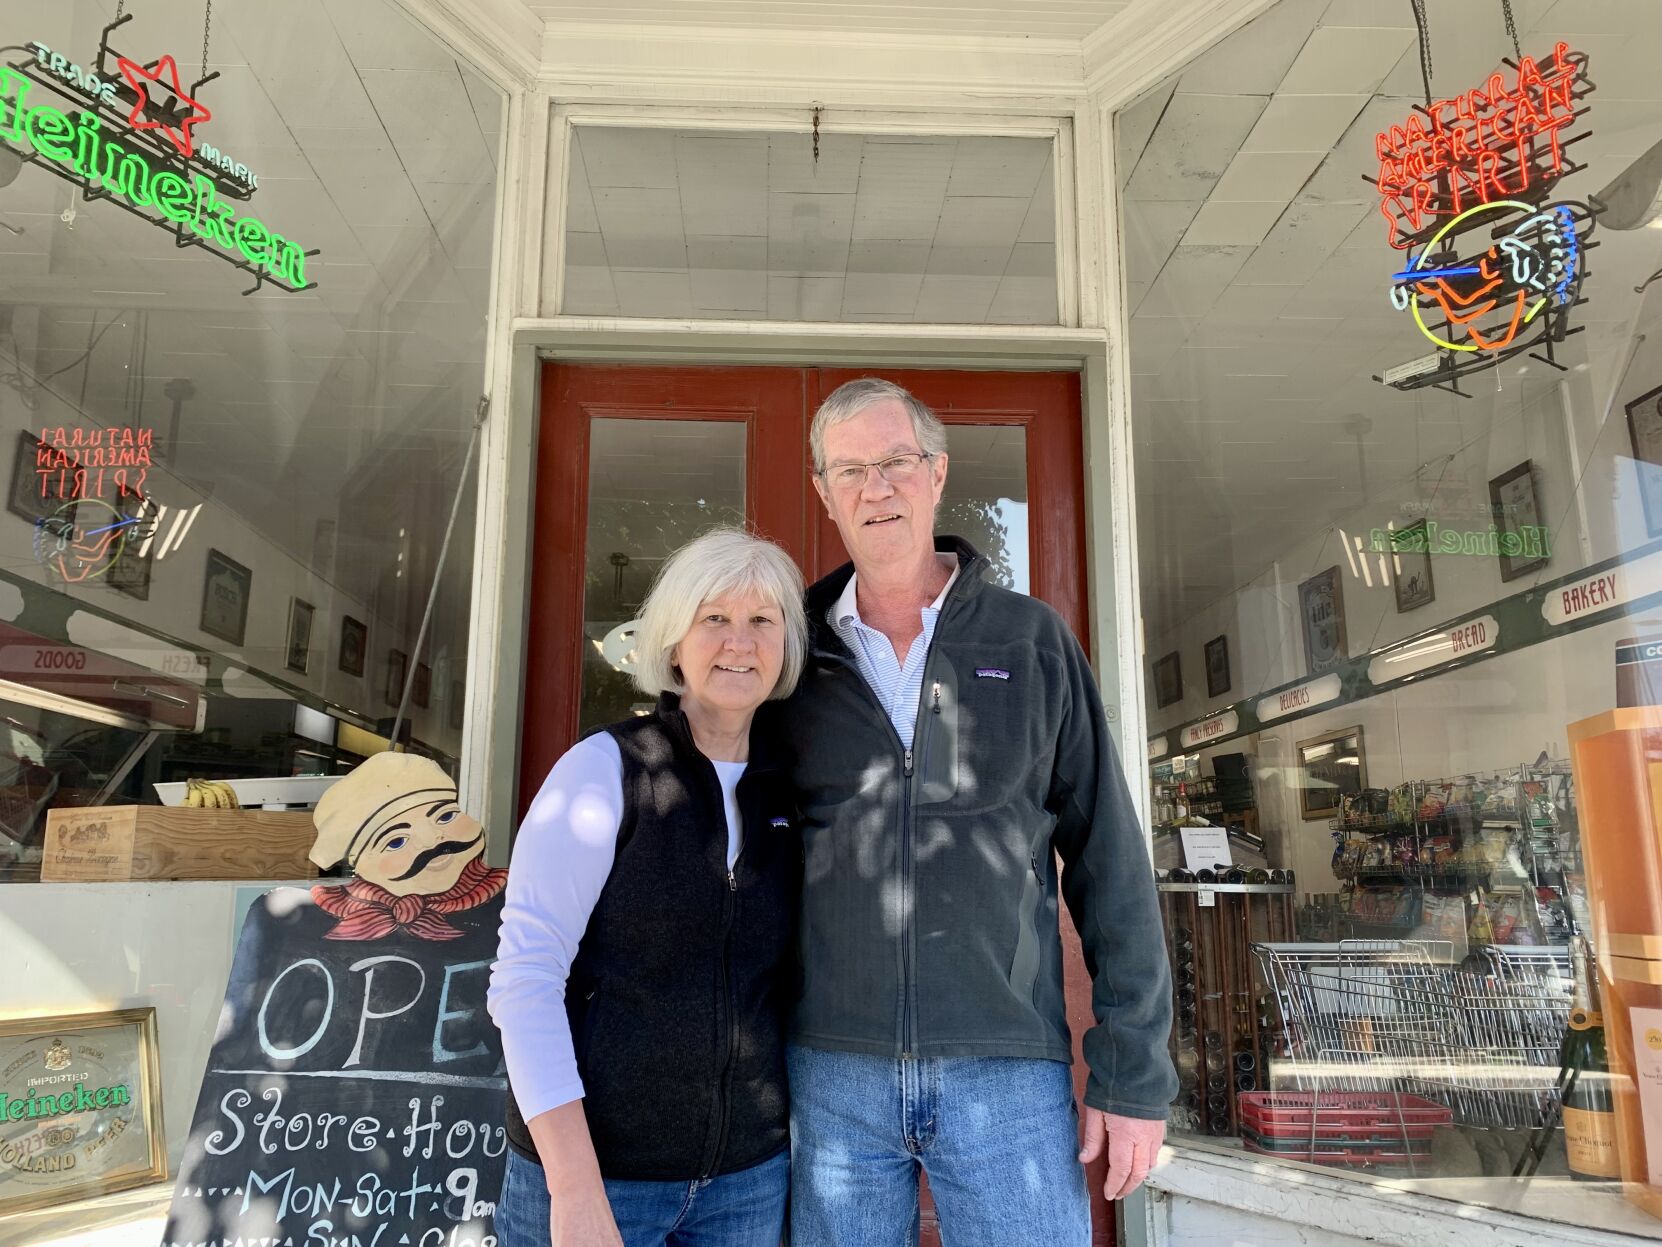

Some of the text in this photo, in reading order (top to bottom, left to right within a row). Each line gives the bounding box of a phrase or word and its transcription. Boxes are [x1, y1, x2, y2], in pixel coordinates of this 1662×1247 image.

[33, 41, 117, 107] TRADE
[1376, 41, 1578, 160] NATURAL
[200, 142, 258, 190] MARK
[1378, 78, 1576, 195] AMERICAN
[1562, 574, 1617, 616] BAKERY
[1451, 621, 1486, 653] BREAD
[258, 955, 506, 1076] OPE
[27, 1072, 89, 1087] IMPORTED
[204, 1087, 507, 1159] Store Hou
